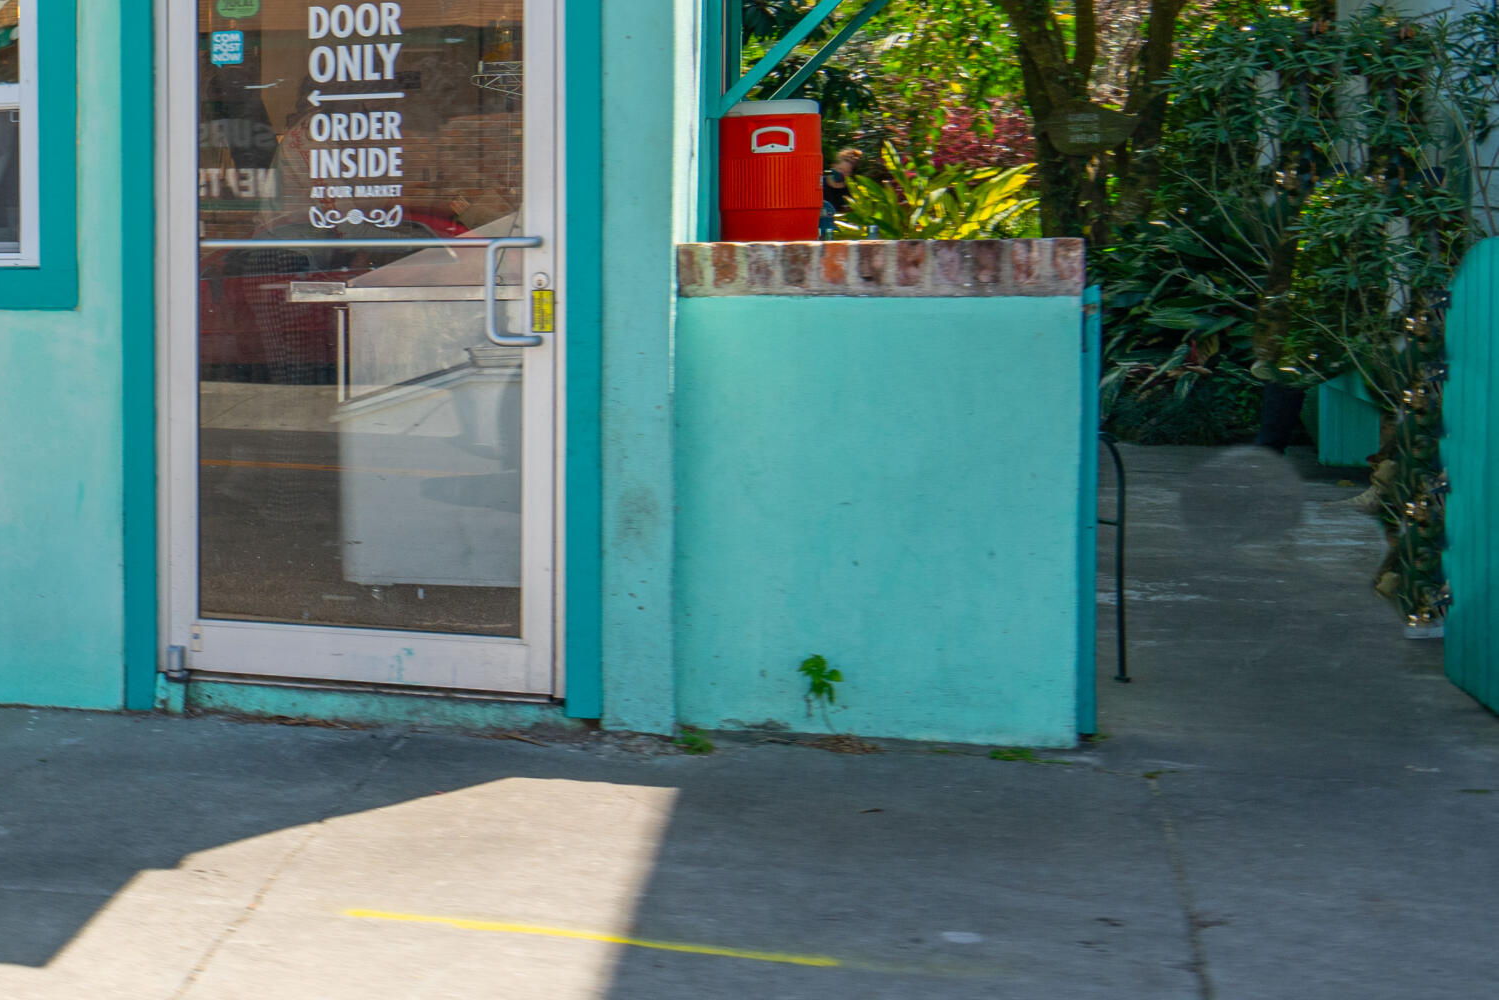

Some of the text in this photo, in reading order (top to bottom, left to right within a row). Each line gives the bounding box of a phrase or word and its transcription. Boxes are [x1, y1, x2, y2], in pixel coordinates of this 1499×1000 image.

[307, 2, 403, 39] DOOR
[308, 43, 403, 83] ONLY
[309, 111, 403, 142] ORDER
[309, 146, 404, 179] INSIDE
